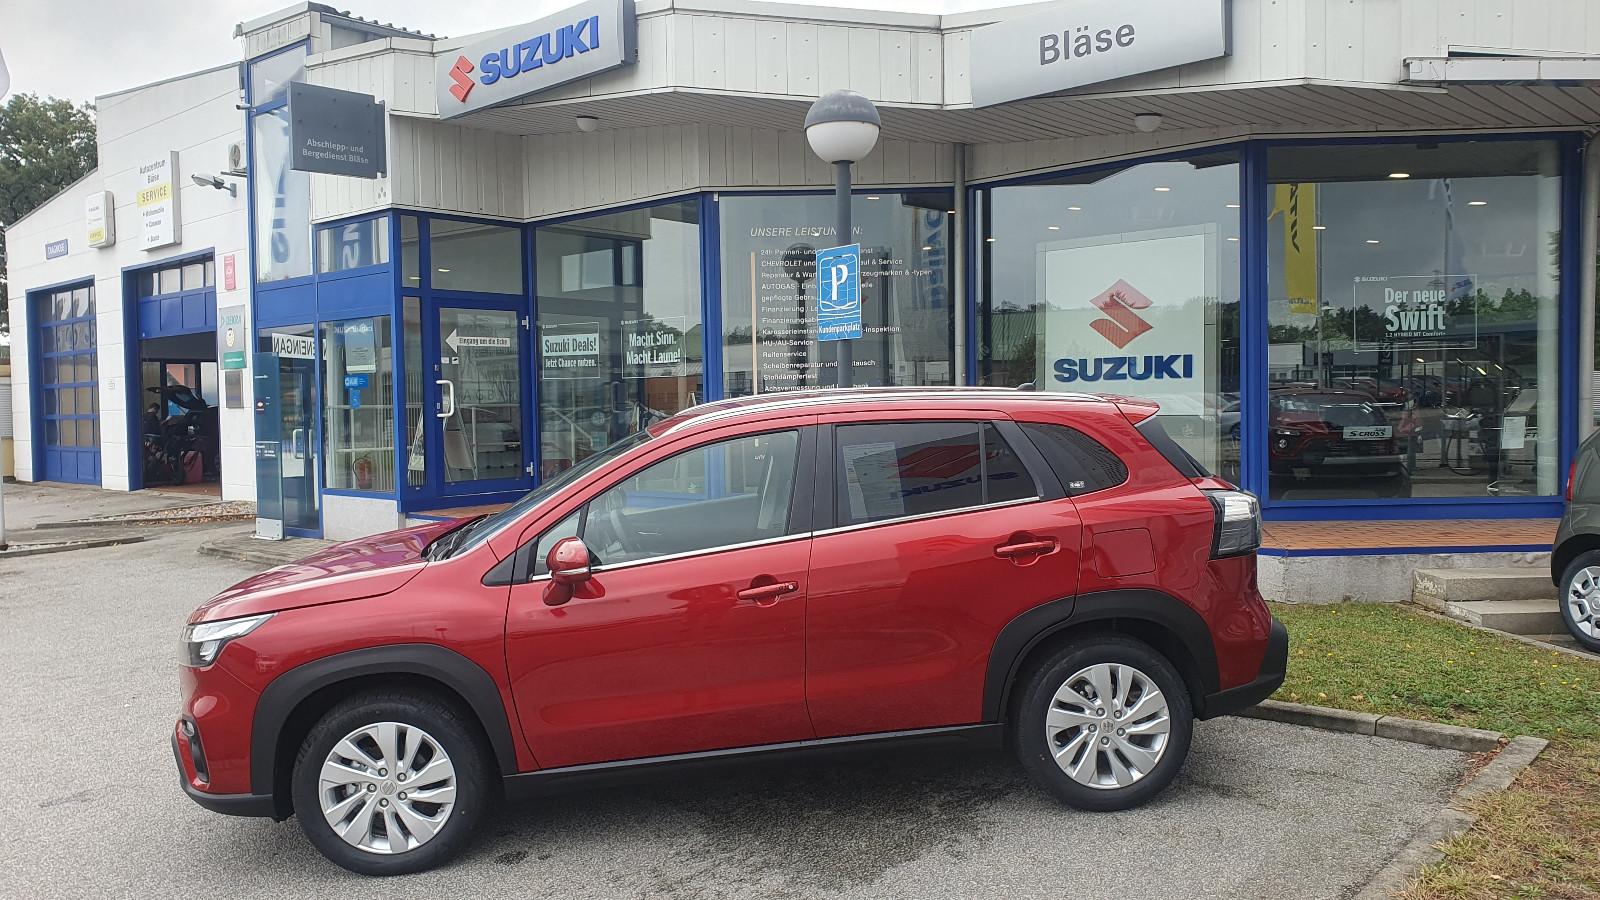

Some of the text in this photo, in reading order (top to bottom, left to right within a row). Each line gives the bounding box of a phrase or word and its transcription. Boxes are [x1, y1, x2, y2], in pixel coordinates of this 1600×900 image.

[479, 15, 600, 86] SUZUKI
[1039, 24, 1135, 66] Bläse
[306, 138, 349, 152] Abschlepp-
[302, 148, 347, 161] Bergedienst
[142, 186, 167, 203] SERVICE
[750, 226, 863, 237] UNSERE LEISTUNN:
[47, 243, 65, 255] DIAGNOSE
[830, 264, 849, 301] P
[1384, 287, 1446, 304] Der neue
[761, 306, 805, 314] Finanzierung
[1385, 303, 1446, 332] Swift
[762, 317, 816, 325] Finanzierungsab
[818, 323, 861, 335] Kundenparkplatz
[459, 337, 479, 346] Eingang
[488, 337, 496, 345] die
[545, 336, 597, 354] Suzuki Deals!
[628, 330, 677, 347] Macht Sinn.
[545, 358, 597, 368] Jetzt Chance nutzen.
[626, 348, 681, 365] Macht Laune!
[763, 361, 824, 369] Scheibenreparatur
[1053, 354, 1193, 383] SUZUKI
